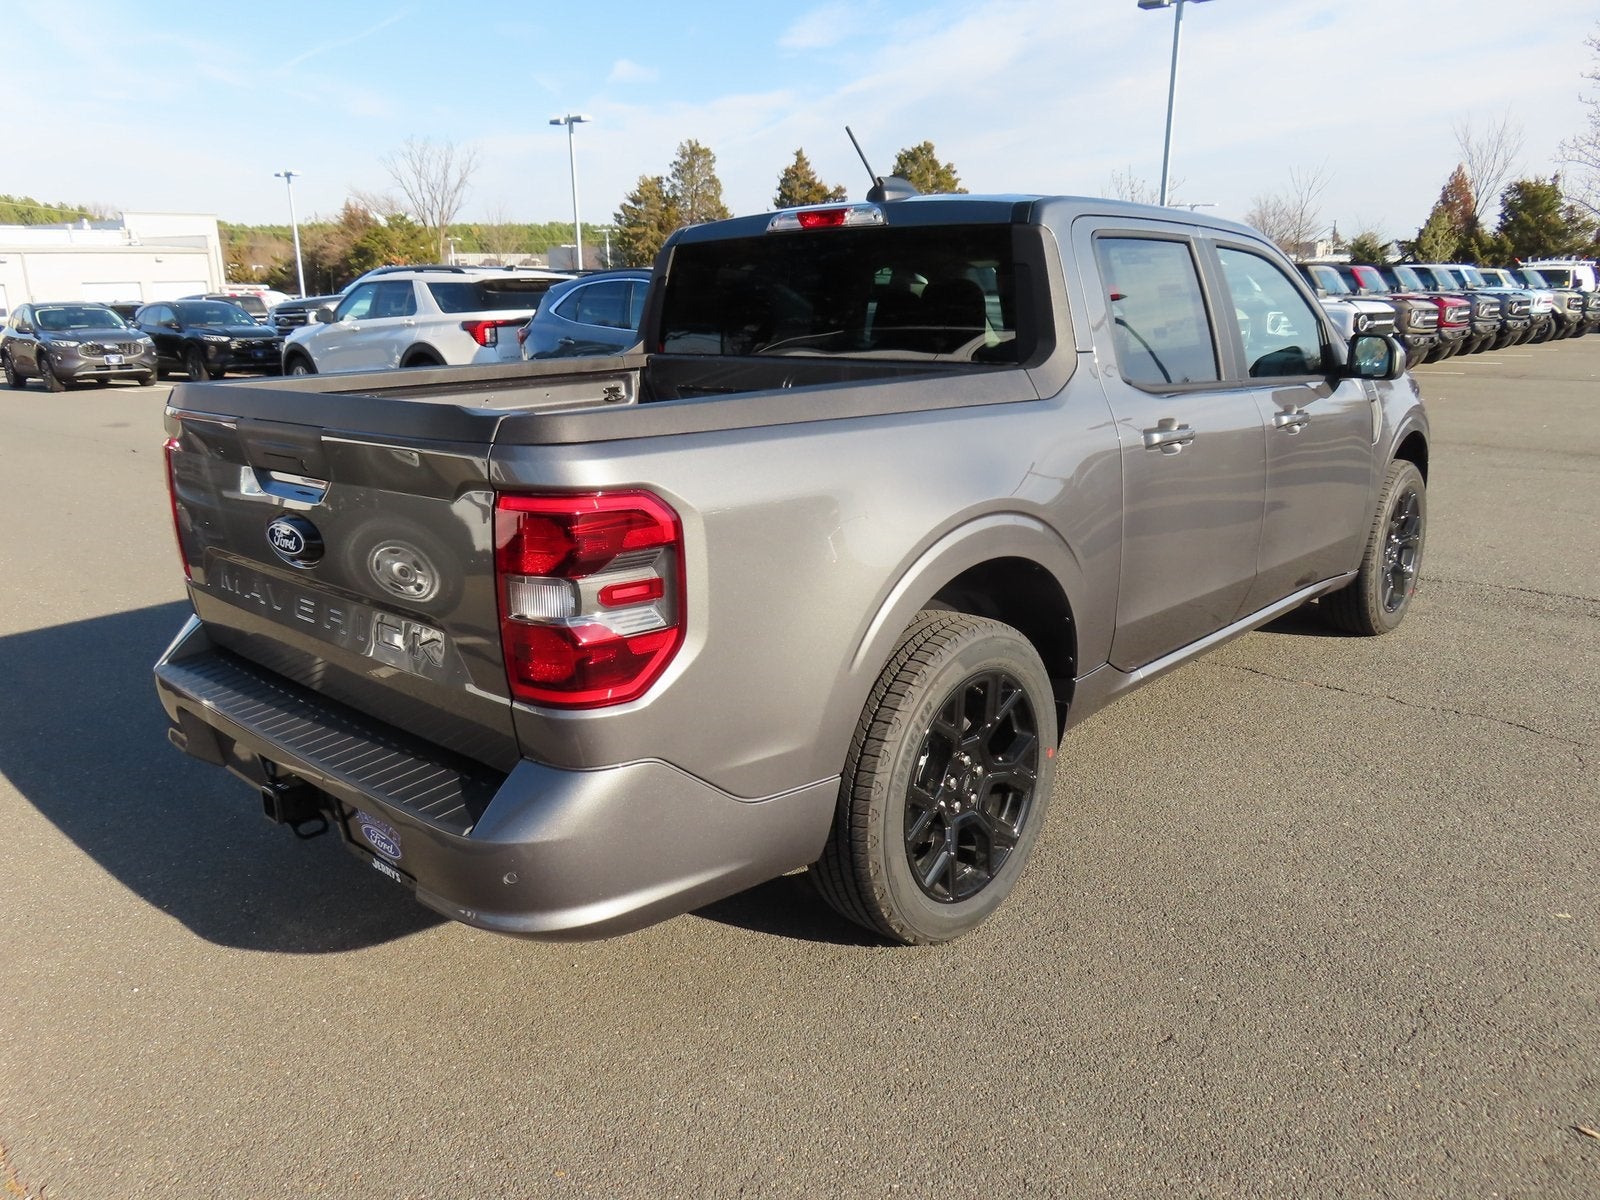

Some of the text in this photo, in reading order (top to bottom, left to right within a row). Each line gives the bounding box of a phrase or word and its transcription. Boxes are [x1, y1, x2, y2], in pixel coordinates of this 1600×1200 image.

[273, 525, 297, 551] Ford
[220, 567, 443, 668] MAVERICK
[370, 830, 395, 854] Ford
